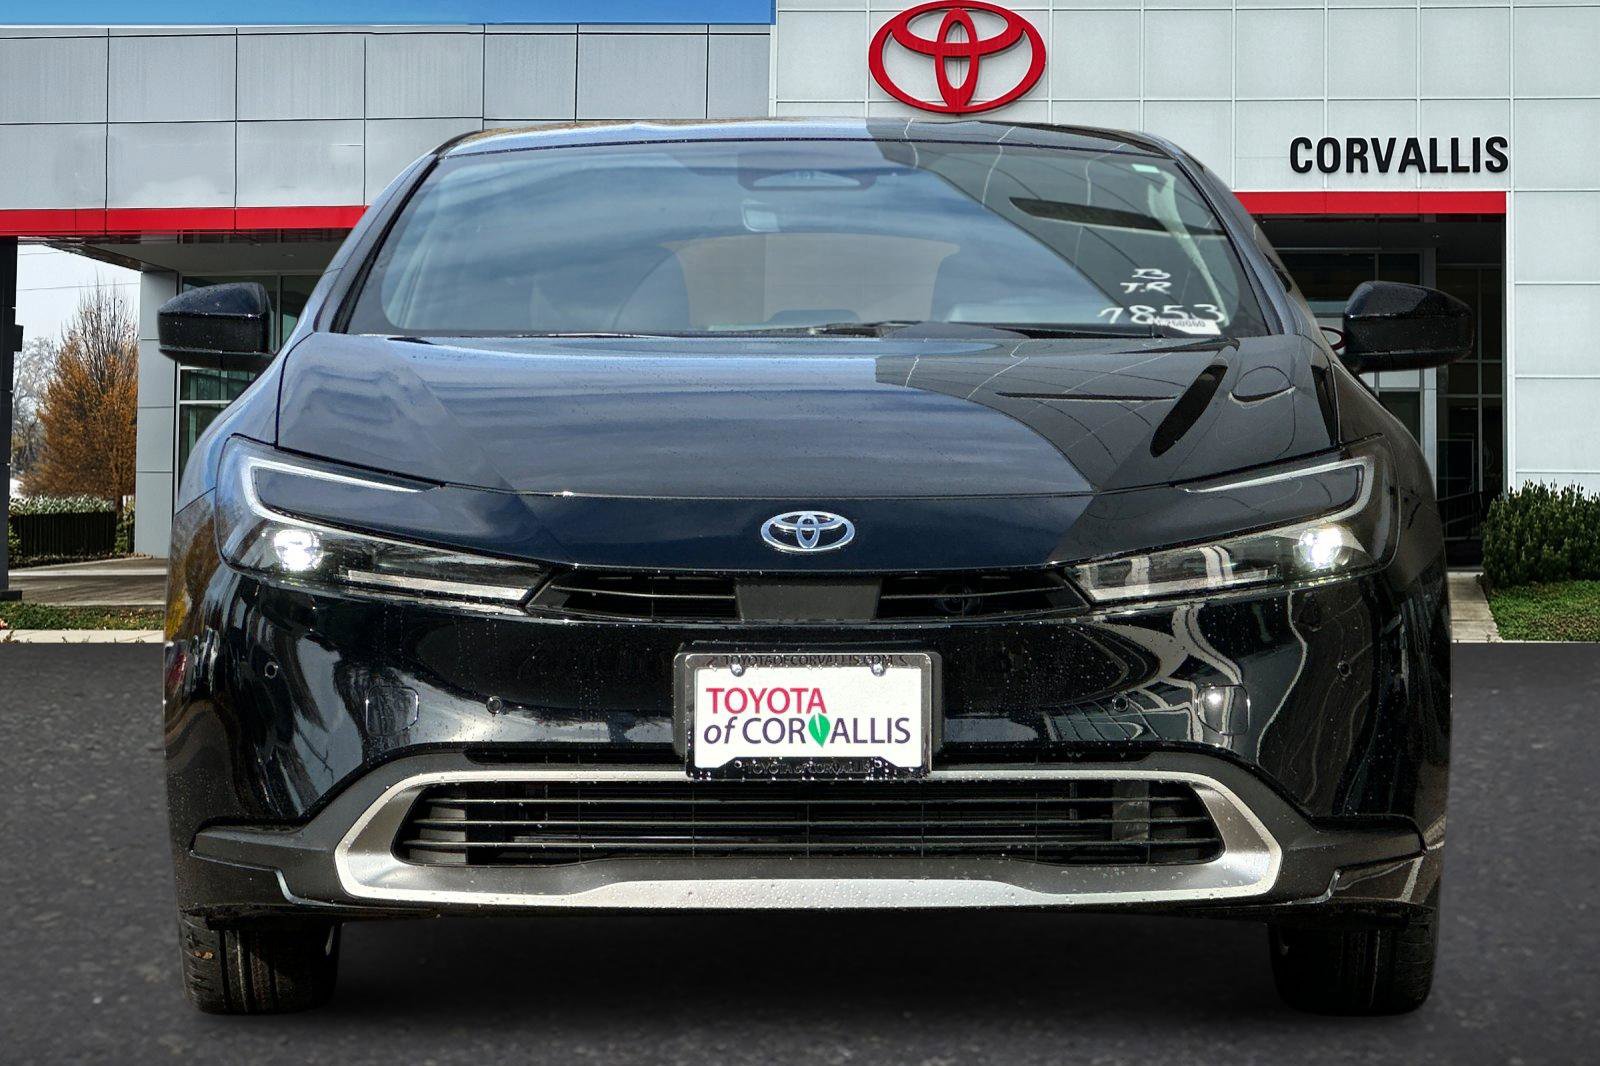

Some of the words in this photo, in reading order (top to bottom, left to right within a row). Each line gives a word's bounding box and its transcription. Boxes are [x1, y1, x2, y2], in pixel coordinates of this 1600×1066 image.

[1290, 136, 1509, 174] CORVALLIS
[706, 687, 827, 714] TOYOTA
[704, 716, 738, 744] of
